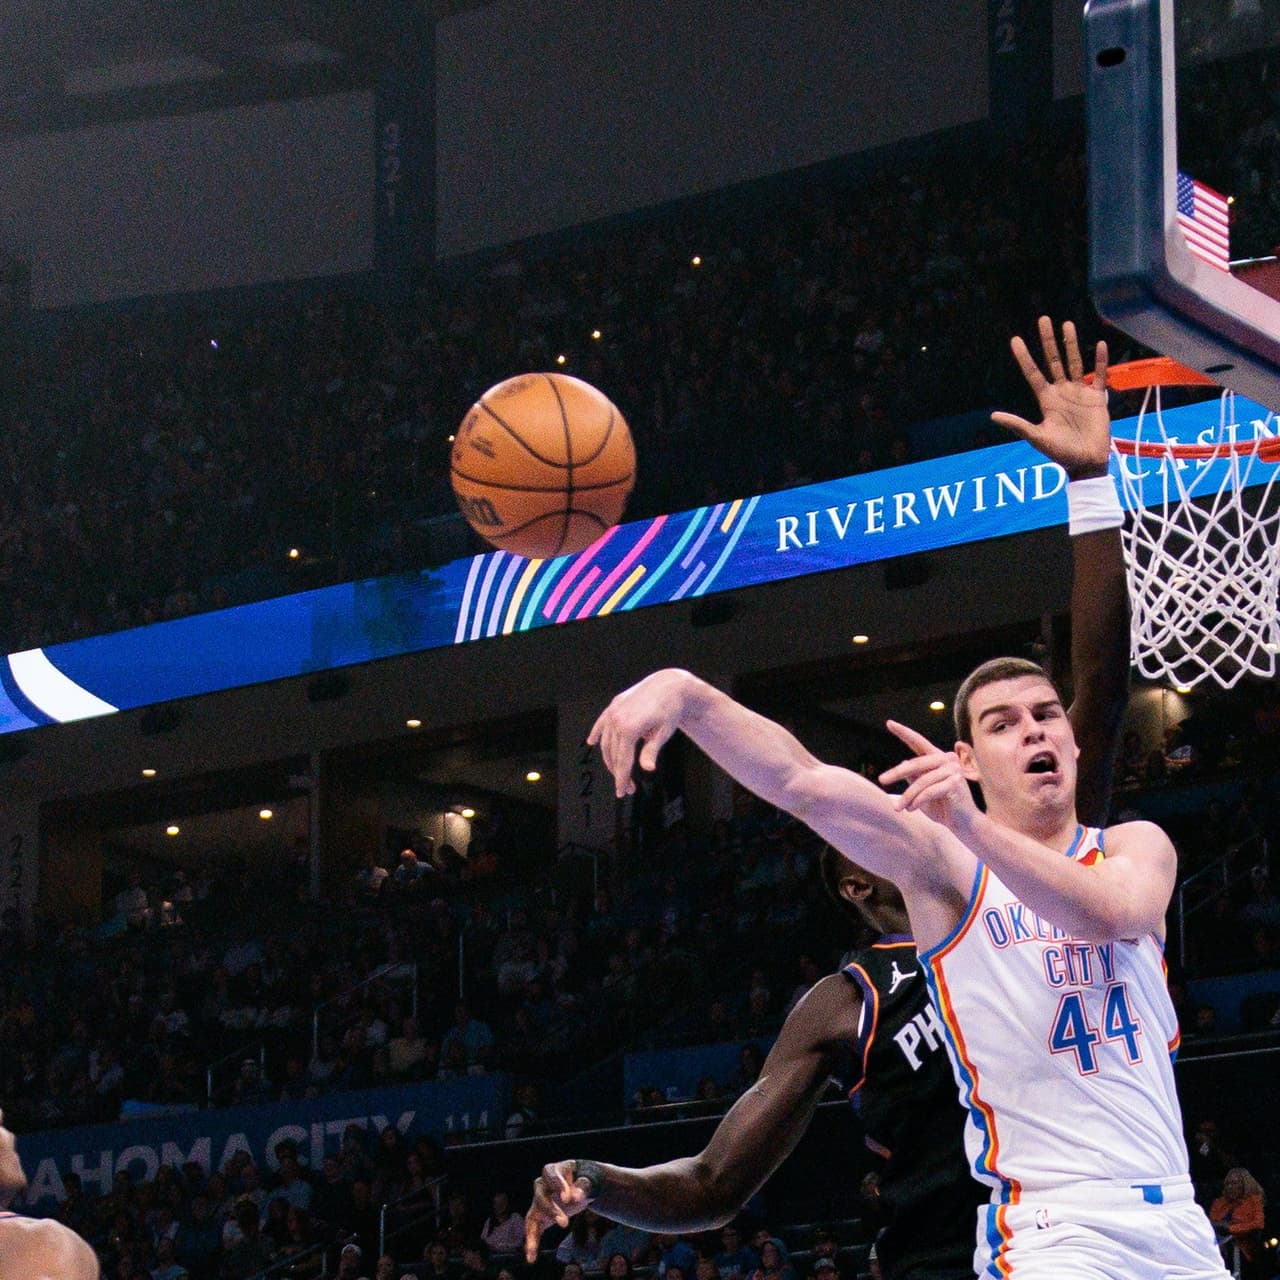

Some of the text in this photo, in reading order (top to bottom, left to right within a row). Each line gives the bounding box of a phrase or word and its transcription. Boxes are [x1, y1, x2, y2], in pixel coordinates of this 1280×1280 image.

[776, 462, 1067, 552] RIVERWIND
[1042, 943, 1118, 988] CITY
[1049, 981, 1143, 1076] 44
